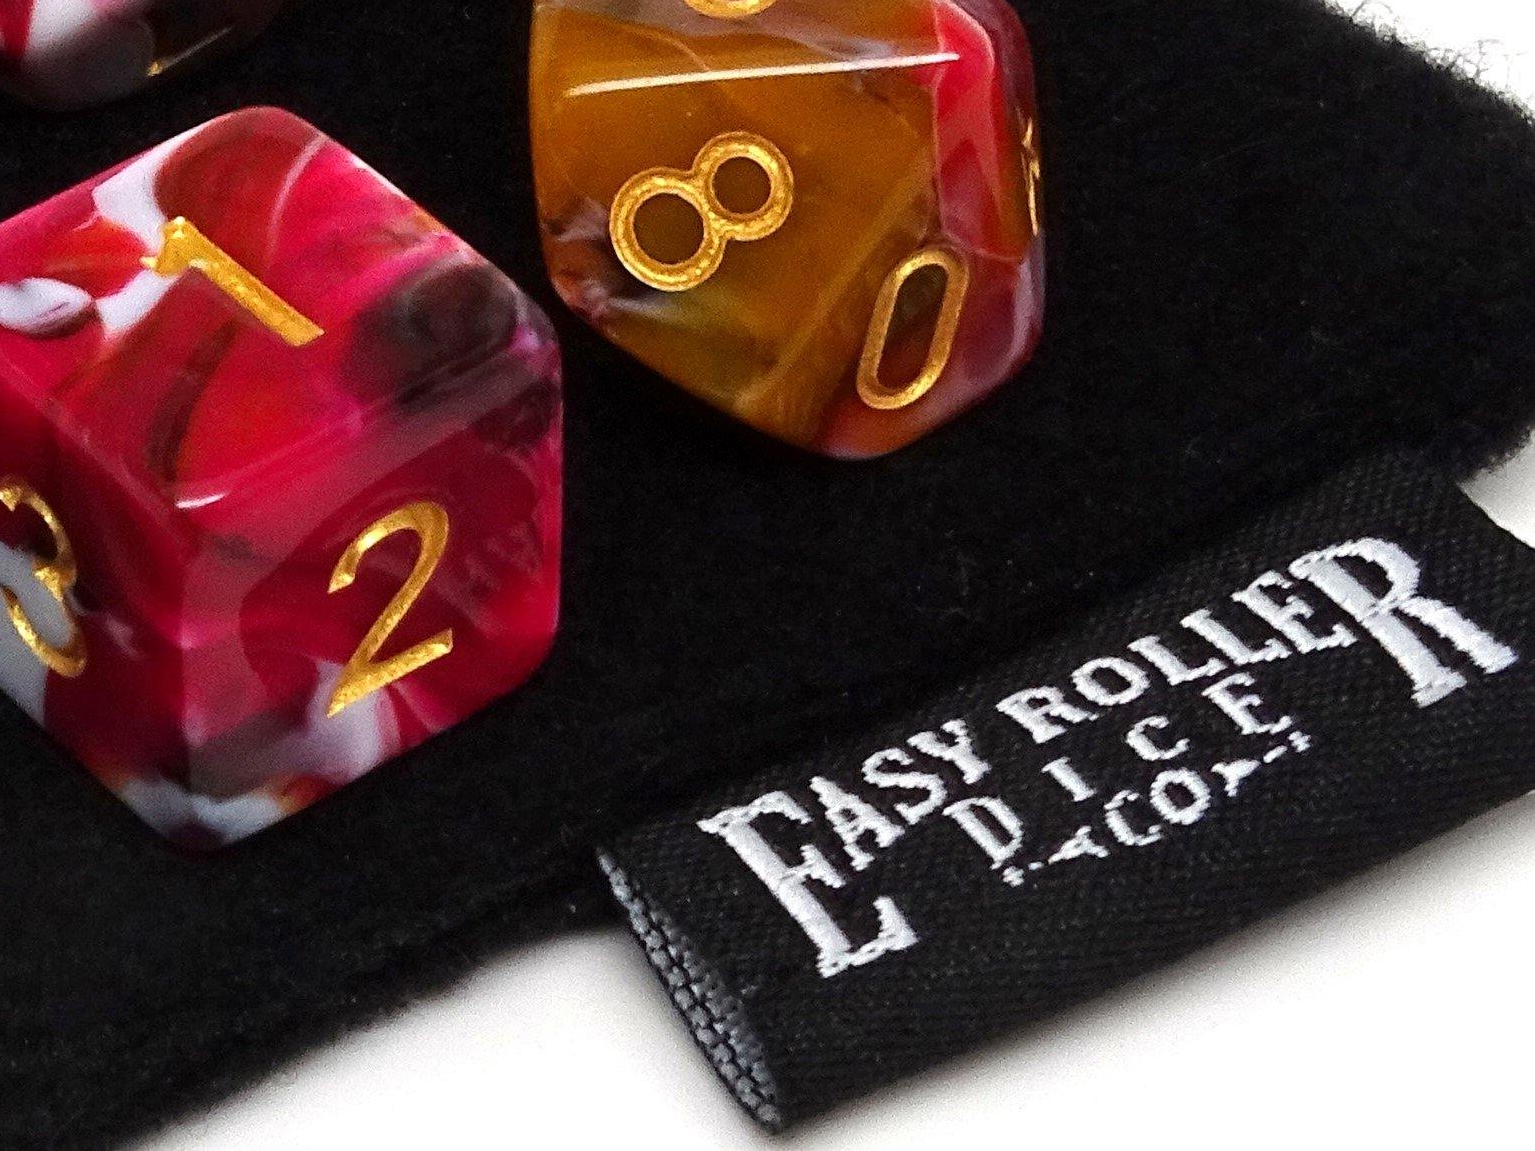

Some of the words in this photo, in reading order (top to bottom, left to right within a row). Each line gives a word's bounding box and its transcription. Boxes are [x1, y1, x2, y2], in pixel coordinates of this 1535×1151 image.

[140, 216, 325, 347] 1
[608, 130, 796, 293] 8
[857, 248, 970, 410] 0
[327, 499, 455, 718] 2
[697, 717, 992, 978] EASY
[996, 536, 1519, 744] ROLLER
